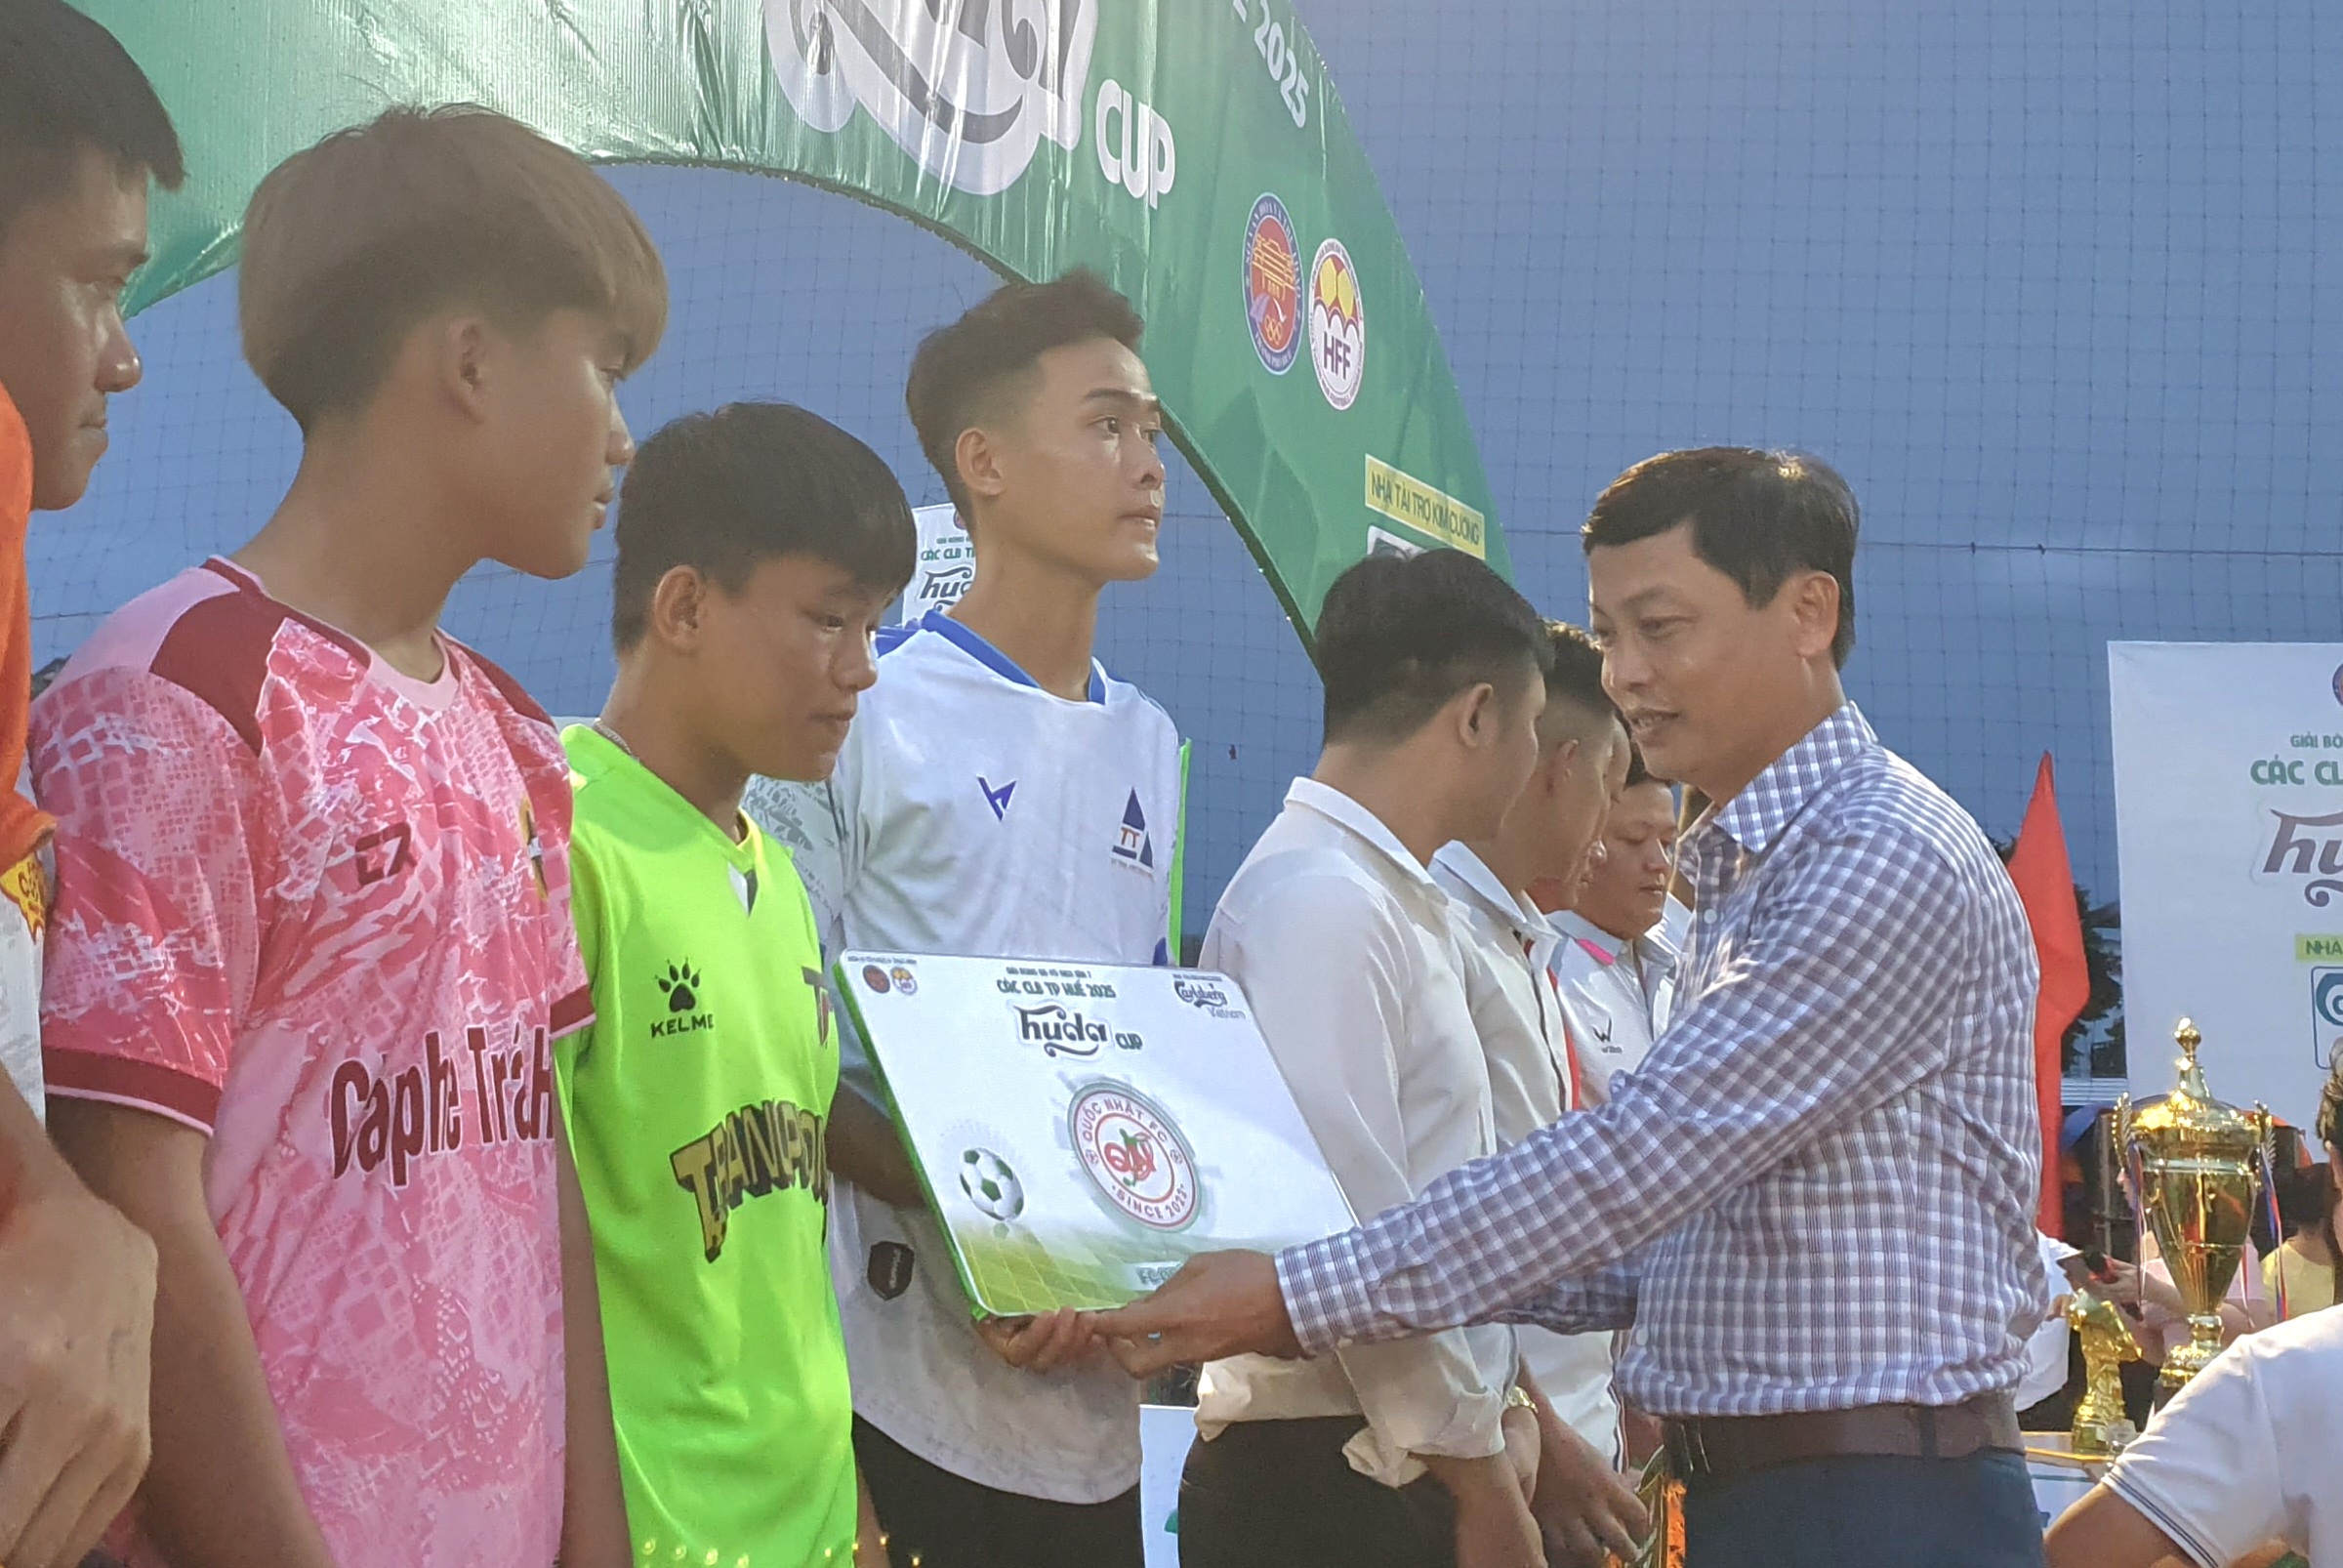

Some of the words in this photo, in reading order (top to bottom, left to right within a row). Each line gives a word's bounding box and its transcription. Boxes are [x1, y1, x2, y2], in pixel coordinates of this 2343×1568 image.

[1095, 78, 1175, 210] CUP
[1324, 330, 1351, 380] HFF
[2250, 754, 2305, 786] CÁC
[650, 1013, 715, 1039] KELME
[1013, 1005, 1107, 1057] huda
[1115, 1033, 1143, 1050] CUP
[1117, 1190, 1164, 1219] SINCE
